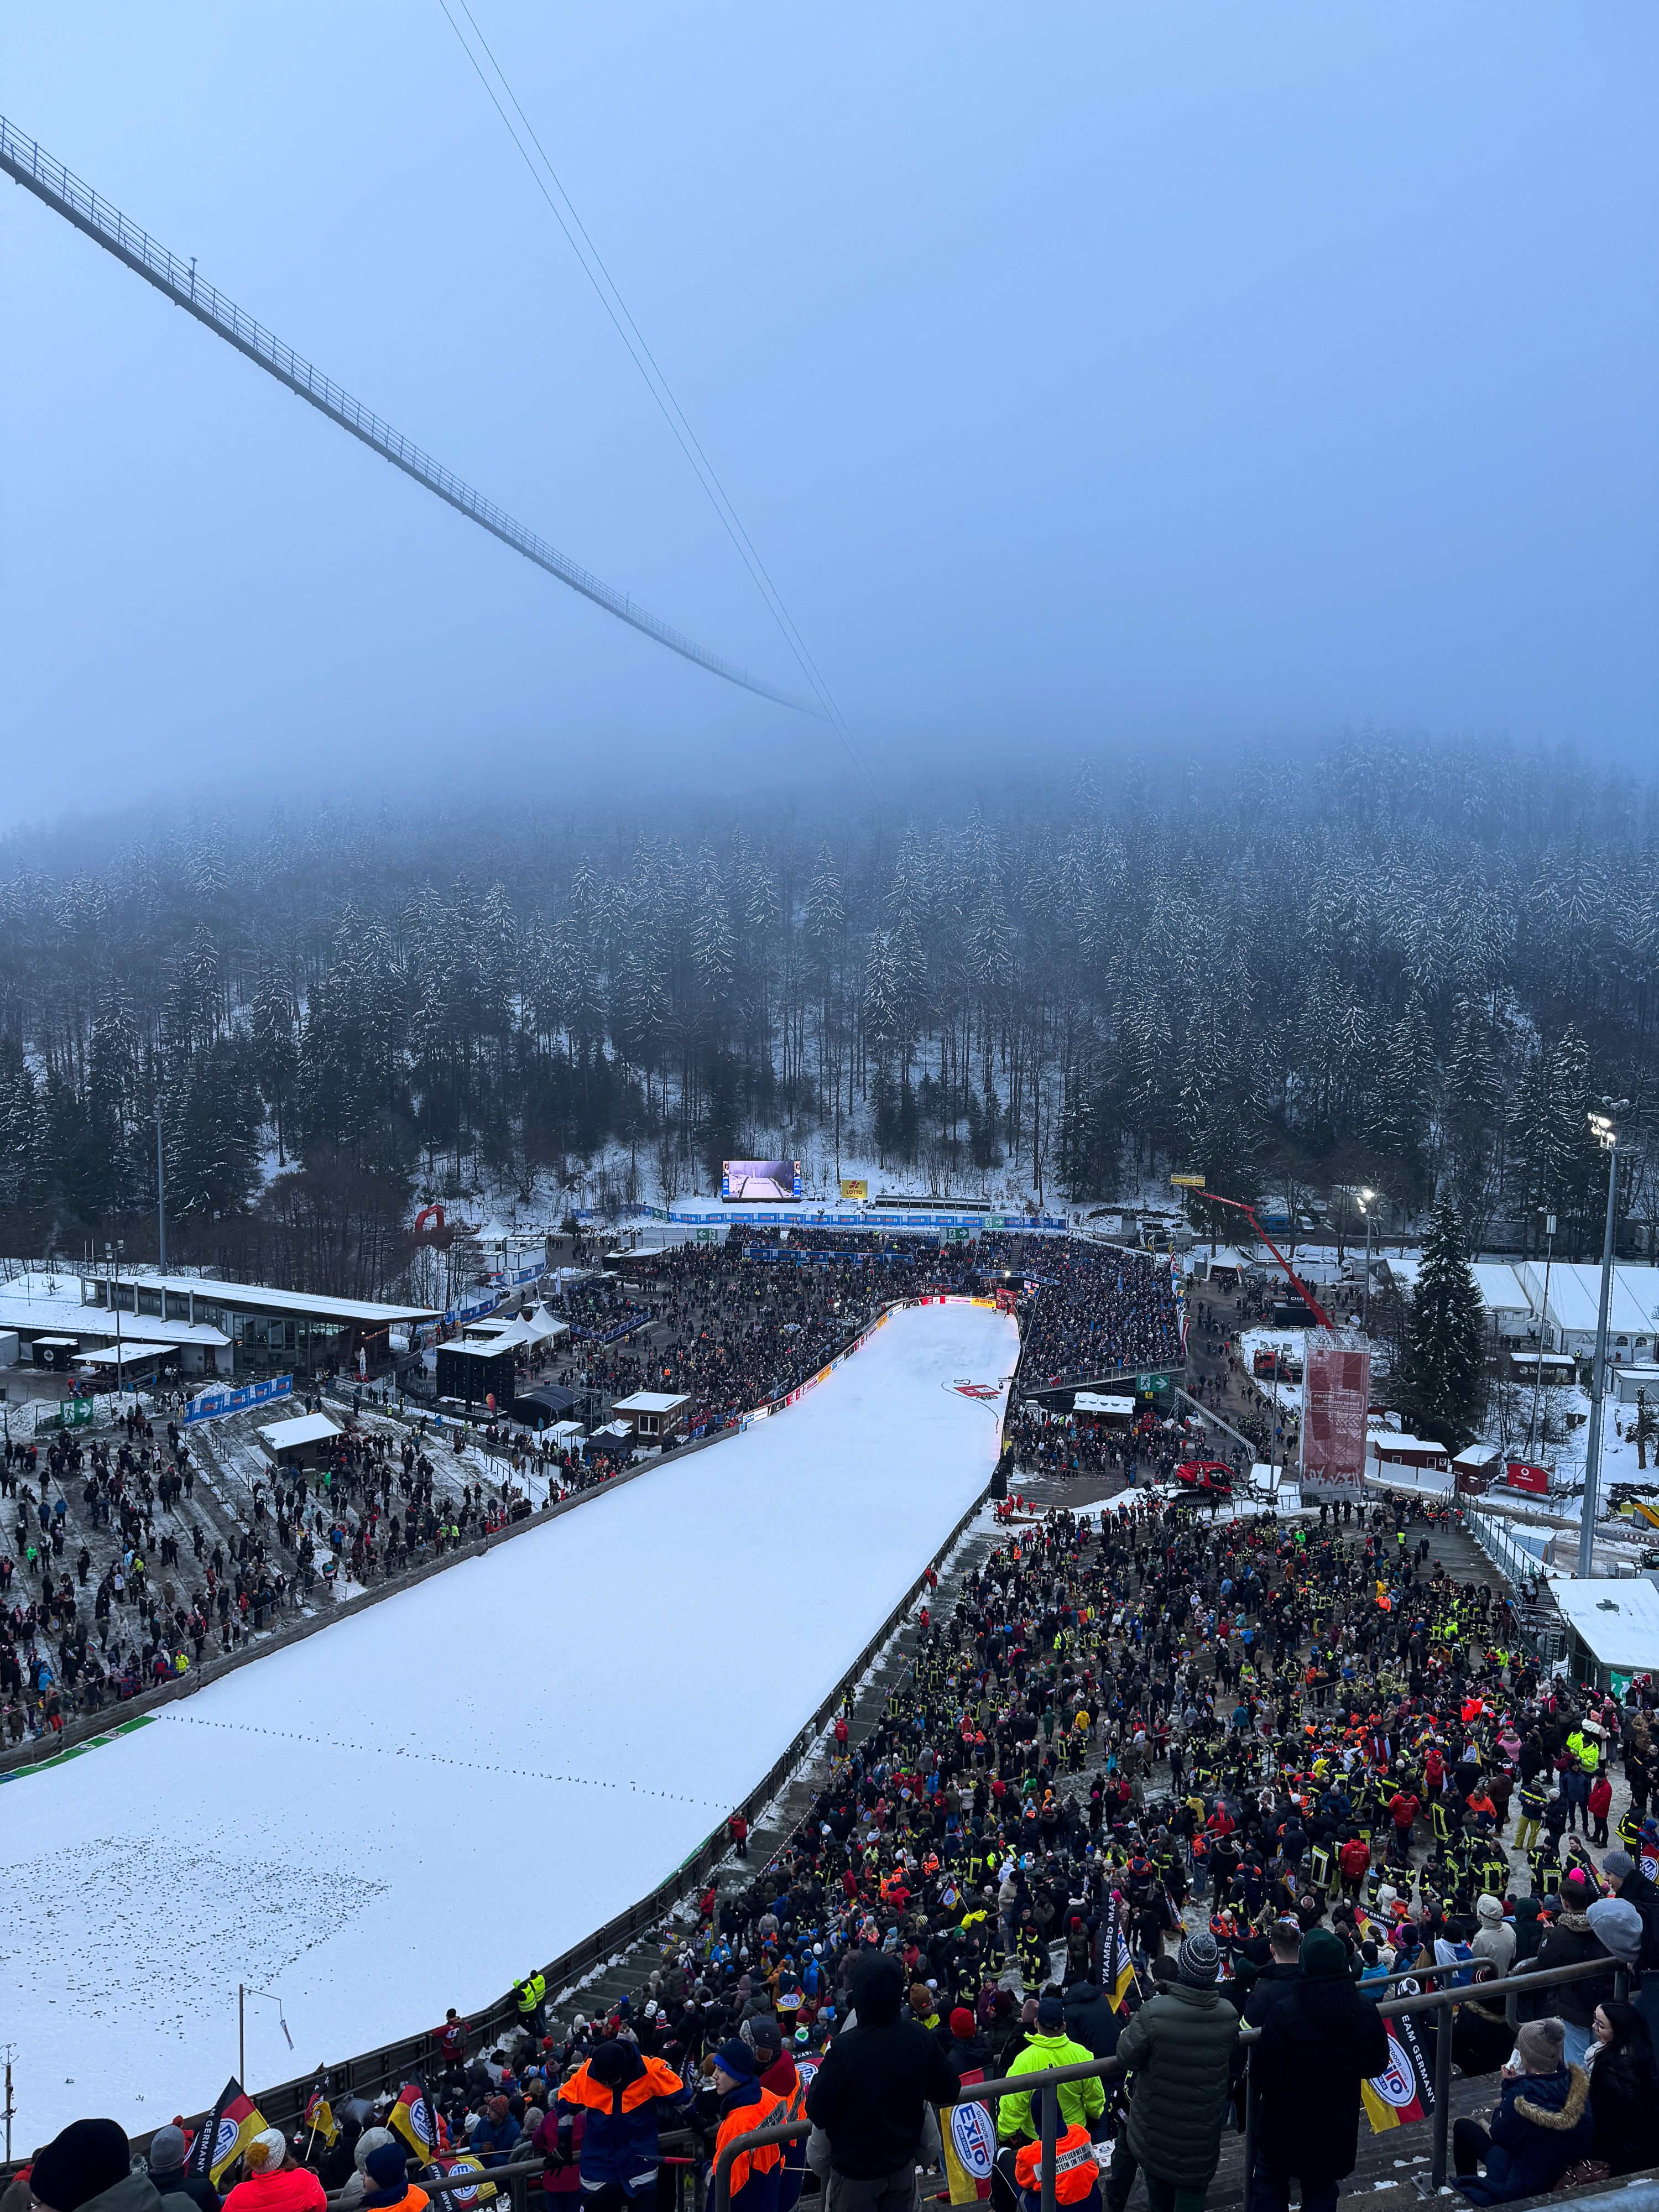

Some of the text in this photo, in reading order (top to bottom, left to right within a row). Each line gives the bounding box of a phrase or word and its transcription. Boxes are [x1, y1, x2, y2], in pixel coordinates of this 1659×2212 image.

[1589, 1875, 1600, 1894] GERMANY
[1369, 1912, 1396, 1924] GERMANY
[1401, 2015, 1436, 2103] EAM GERMANY
[976, 2111, 989, 2140] OUTDOOR
[197, 2121, 213, 2173] GERMANY
[1055, 2162, 1070, 2173] STEIN
